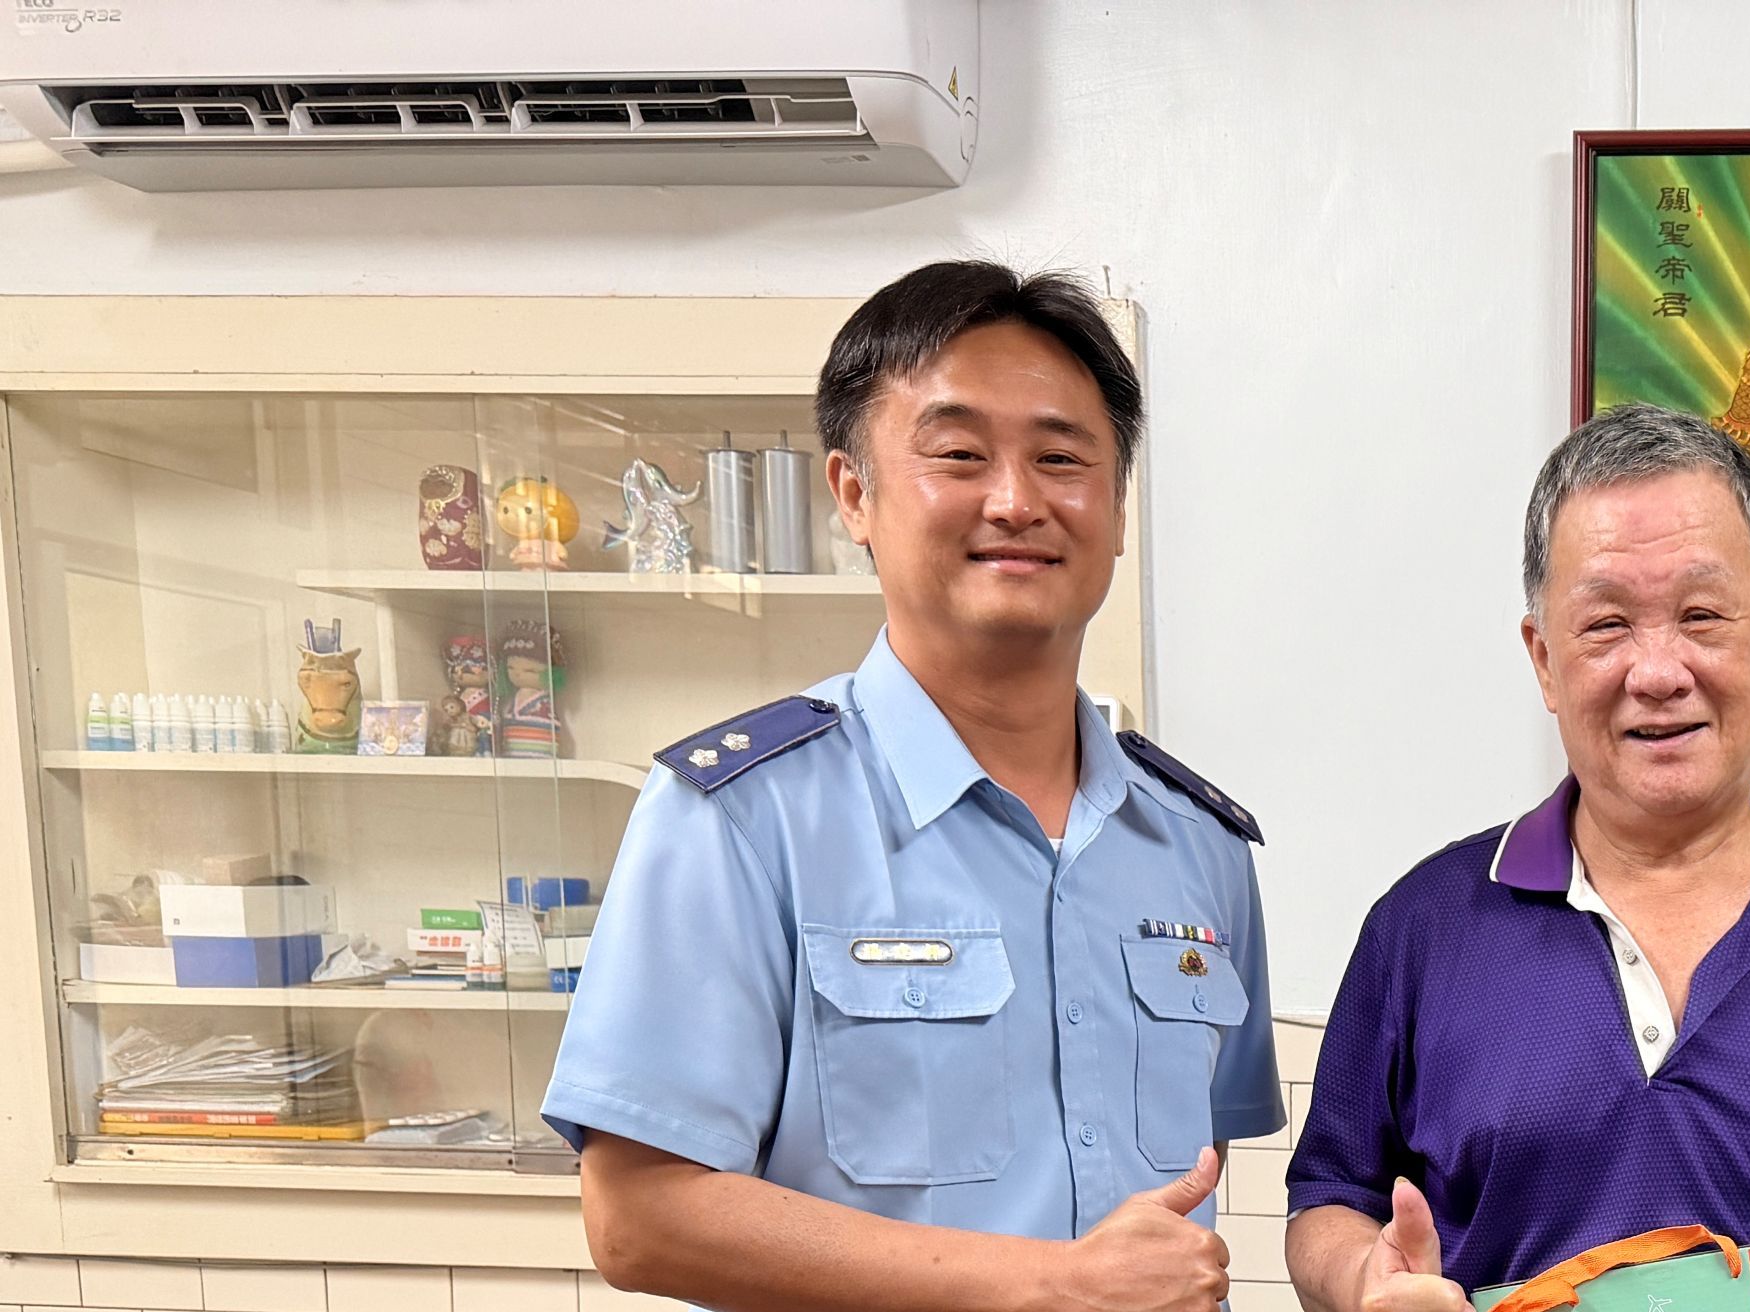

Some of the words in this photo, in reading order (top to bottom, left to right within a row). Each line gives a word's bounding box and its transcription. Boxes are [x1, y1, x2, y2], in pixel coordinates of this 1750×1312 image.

[83, 9, 121, 21] R32
[1653, 187, 1693, 318] 關聖帝君
